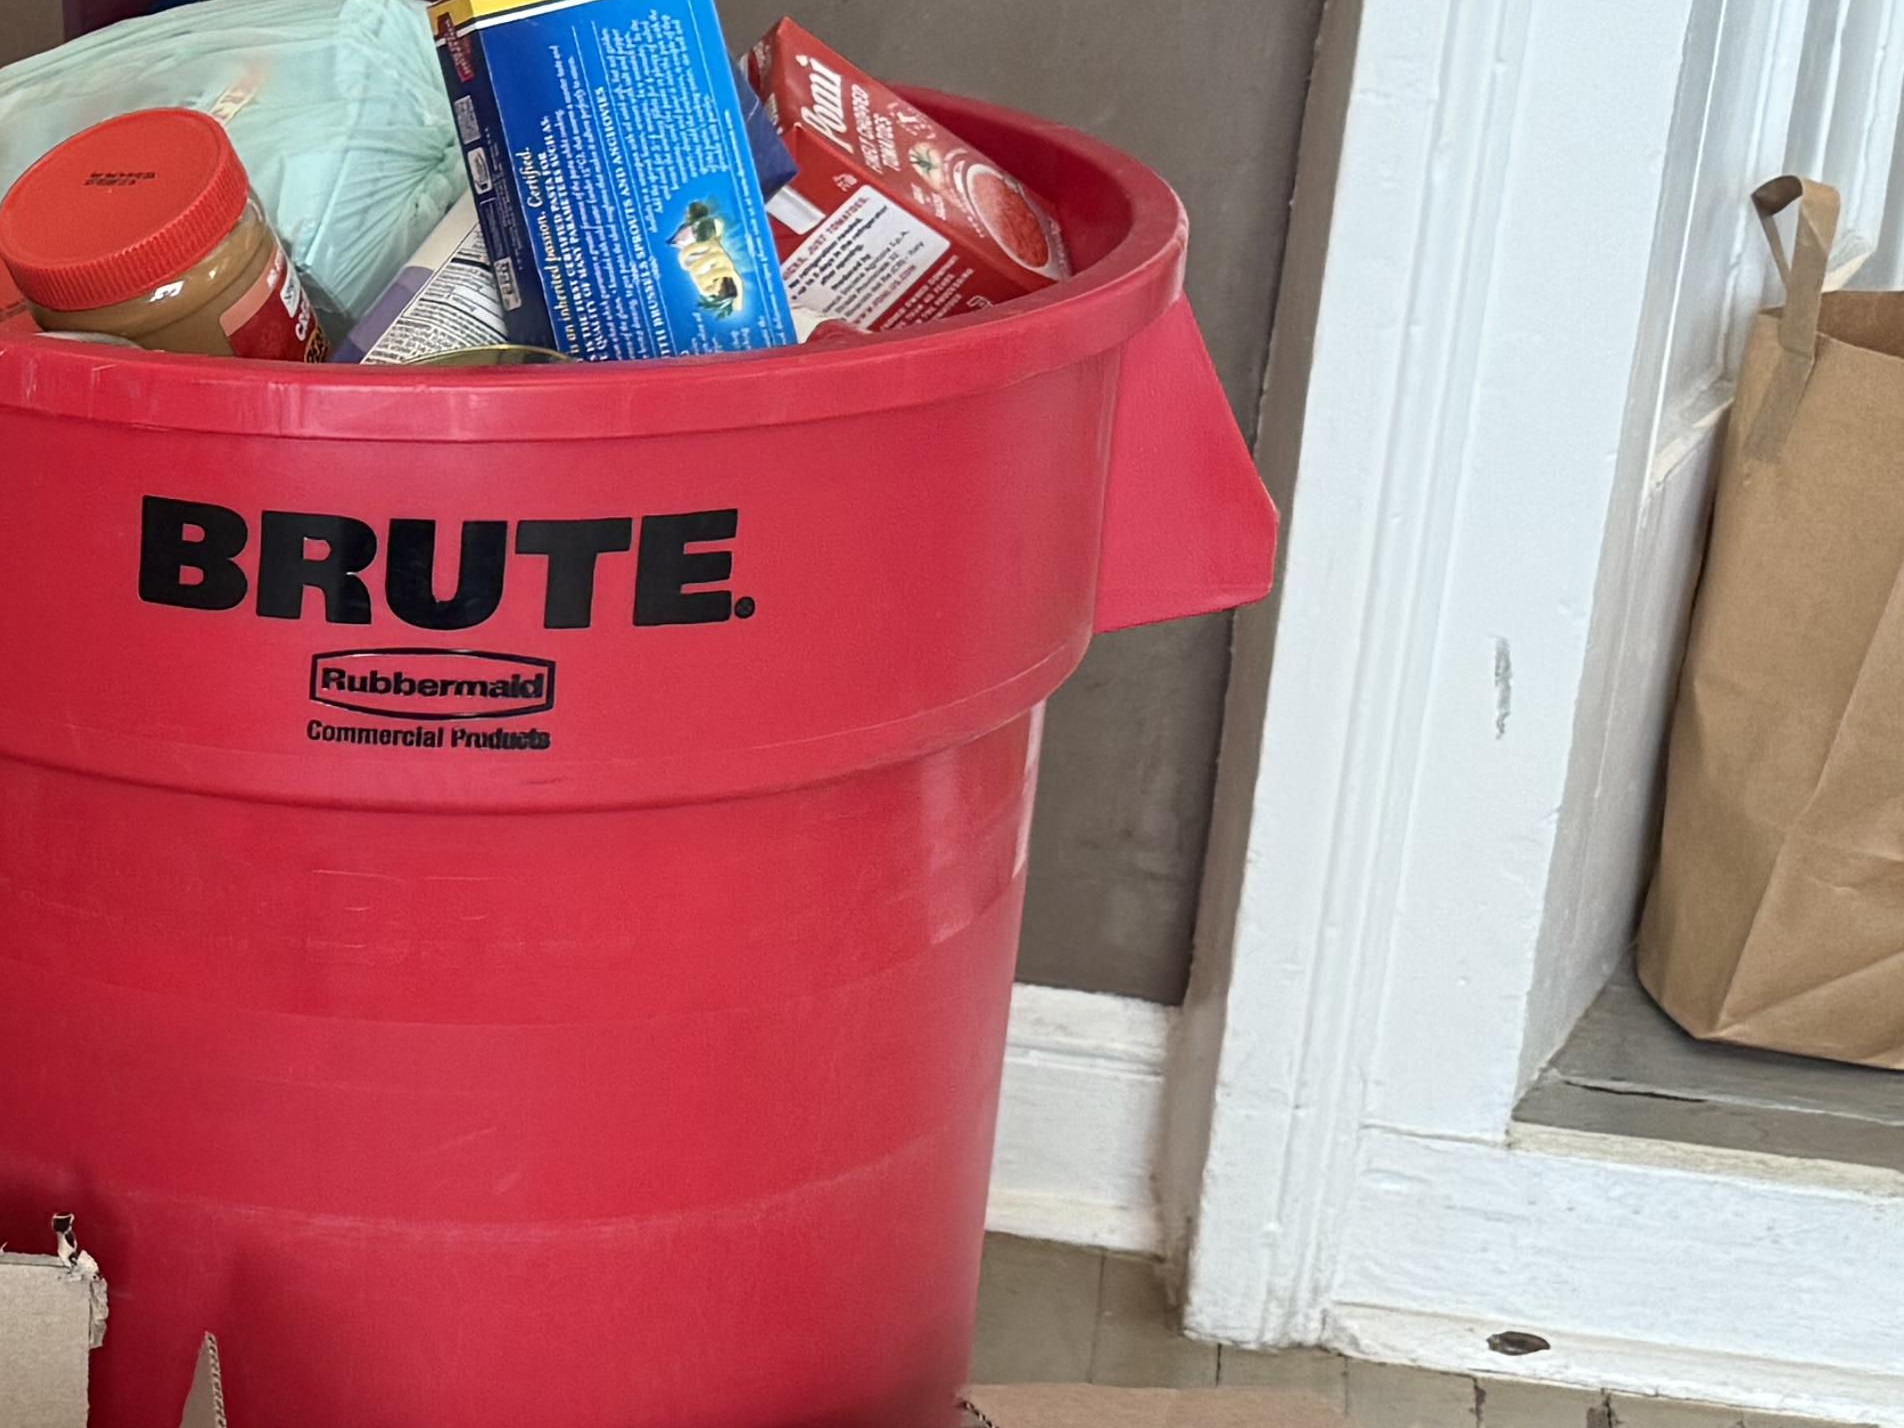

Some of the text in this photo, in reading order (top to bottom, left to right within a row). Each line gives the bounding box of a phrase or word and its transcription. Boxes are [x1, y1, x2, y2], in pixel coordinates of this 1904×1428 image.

[514, 146, 547, 210] Certified.
[594, 86, 664, 327] BRUSSELS SPROUTS AND ANCHOVIES
[552, 212, 576, 278] CERTIFIED
[320, 667, 545, 702] Rubbermaid
[307, 719, 551, 751] Commercial Products
